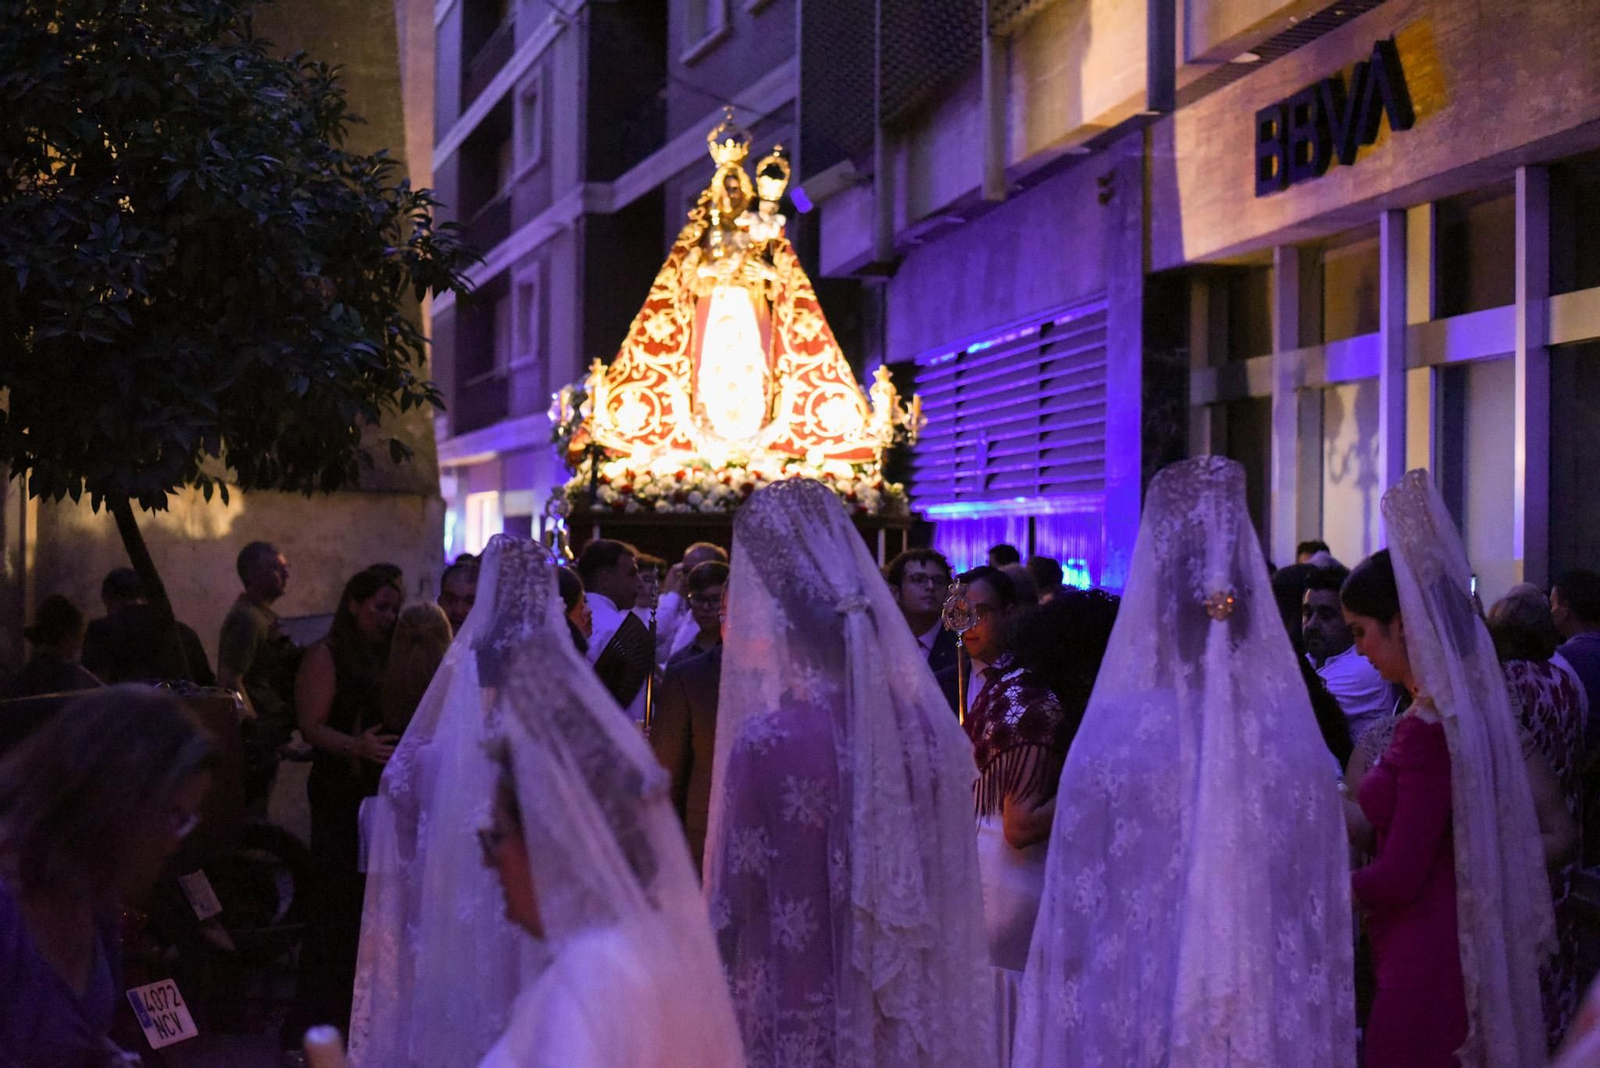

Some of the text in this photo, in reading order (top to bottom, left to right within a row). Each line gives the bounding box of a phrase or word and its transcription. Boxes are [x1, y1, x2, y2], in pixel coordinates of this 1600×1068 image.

[1255, 38, 1415, 198] BBVA
[143, 984, 181, 1013] 4072
[153, 1011, 184, 1040] NCV
